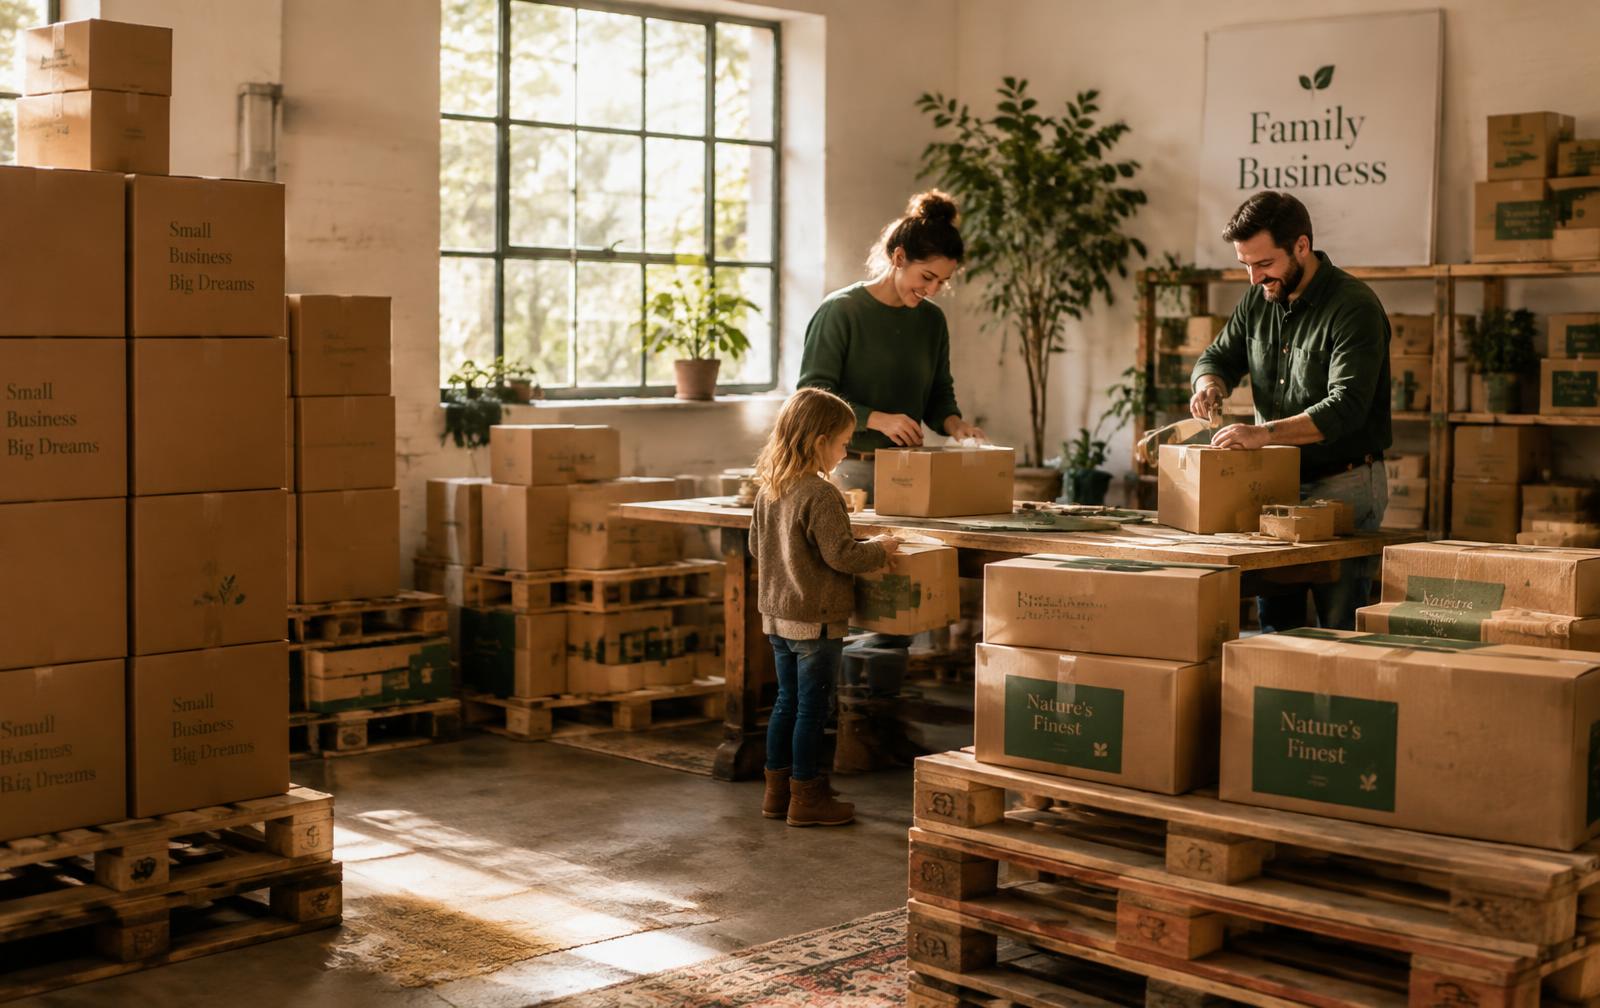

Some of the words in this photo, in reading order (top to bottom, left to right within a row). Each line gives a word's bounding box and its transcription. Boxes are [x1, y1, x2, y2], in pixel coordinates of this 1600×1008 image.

[1250, 105, 1366, 150] Family
[1238, 154, 1388, 190] Business
[168, 220, 212, 239] Small
[168, 246, 233, 265] Business
[168, 273, 194, 295] Big
[198, 273, 255, 291] Dreams
[6, 381, 53, 401] Small
[7, 410, 77, 428] Business
[8, 438, 34, 460] Big
[39, 437, 100, 455] Dreams
[171, 690, 214, 713] Small
[1026, 693, 1094, 718] Nature's
[171, 719, 235, 738] Business
[1033, 714, 1082, 735] Finest
[1280, 711, 1362, 740] Nature's
[1288, 737, 1346, 765] Finest
